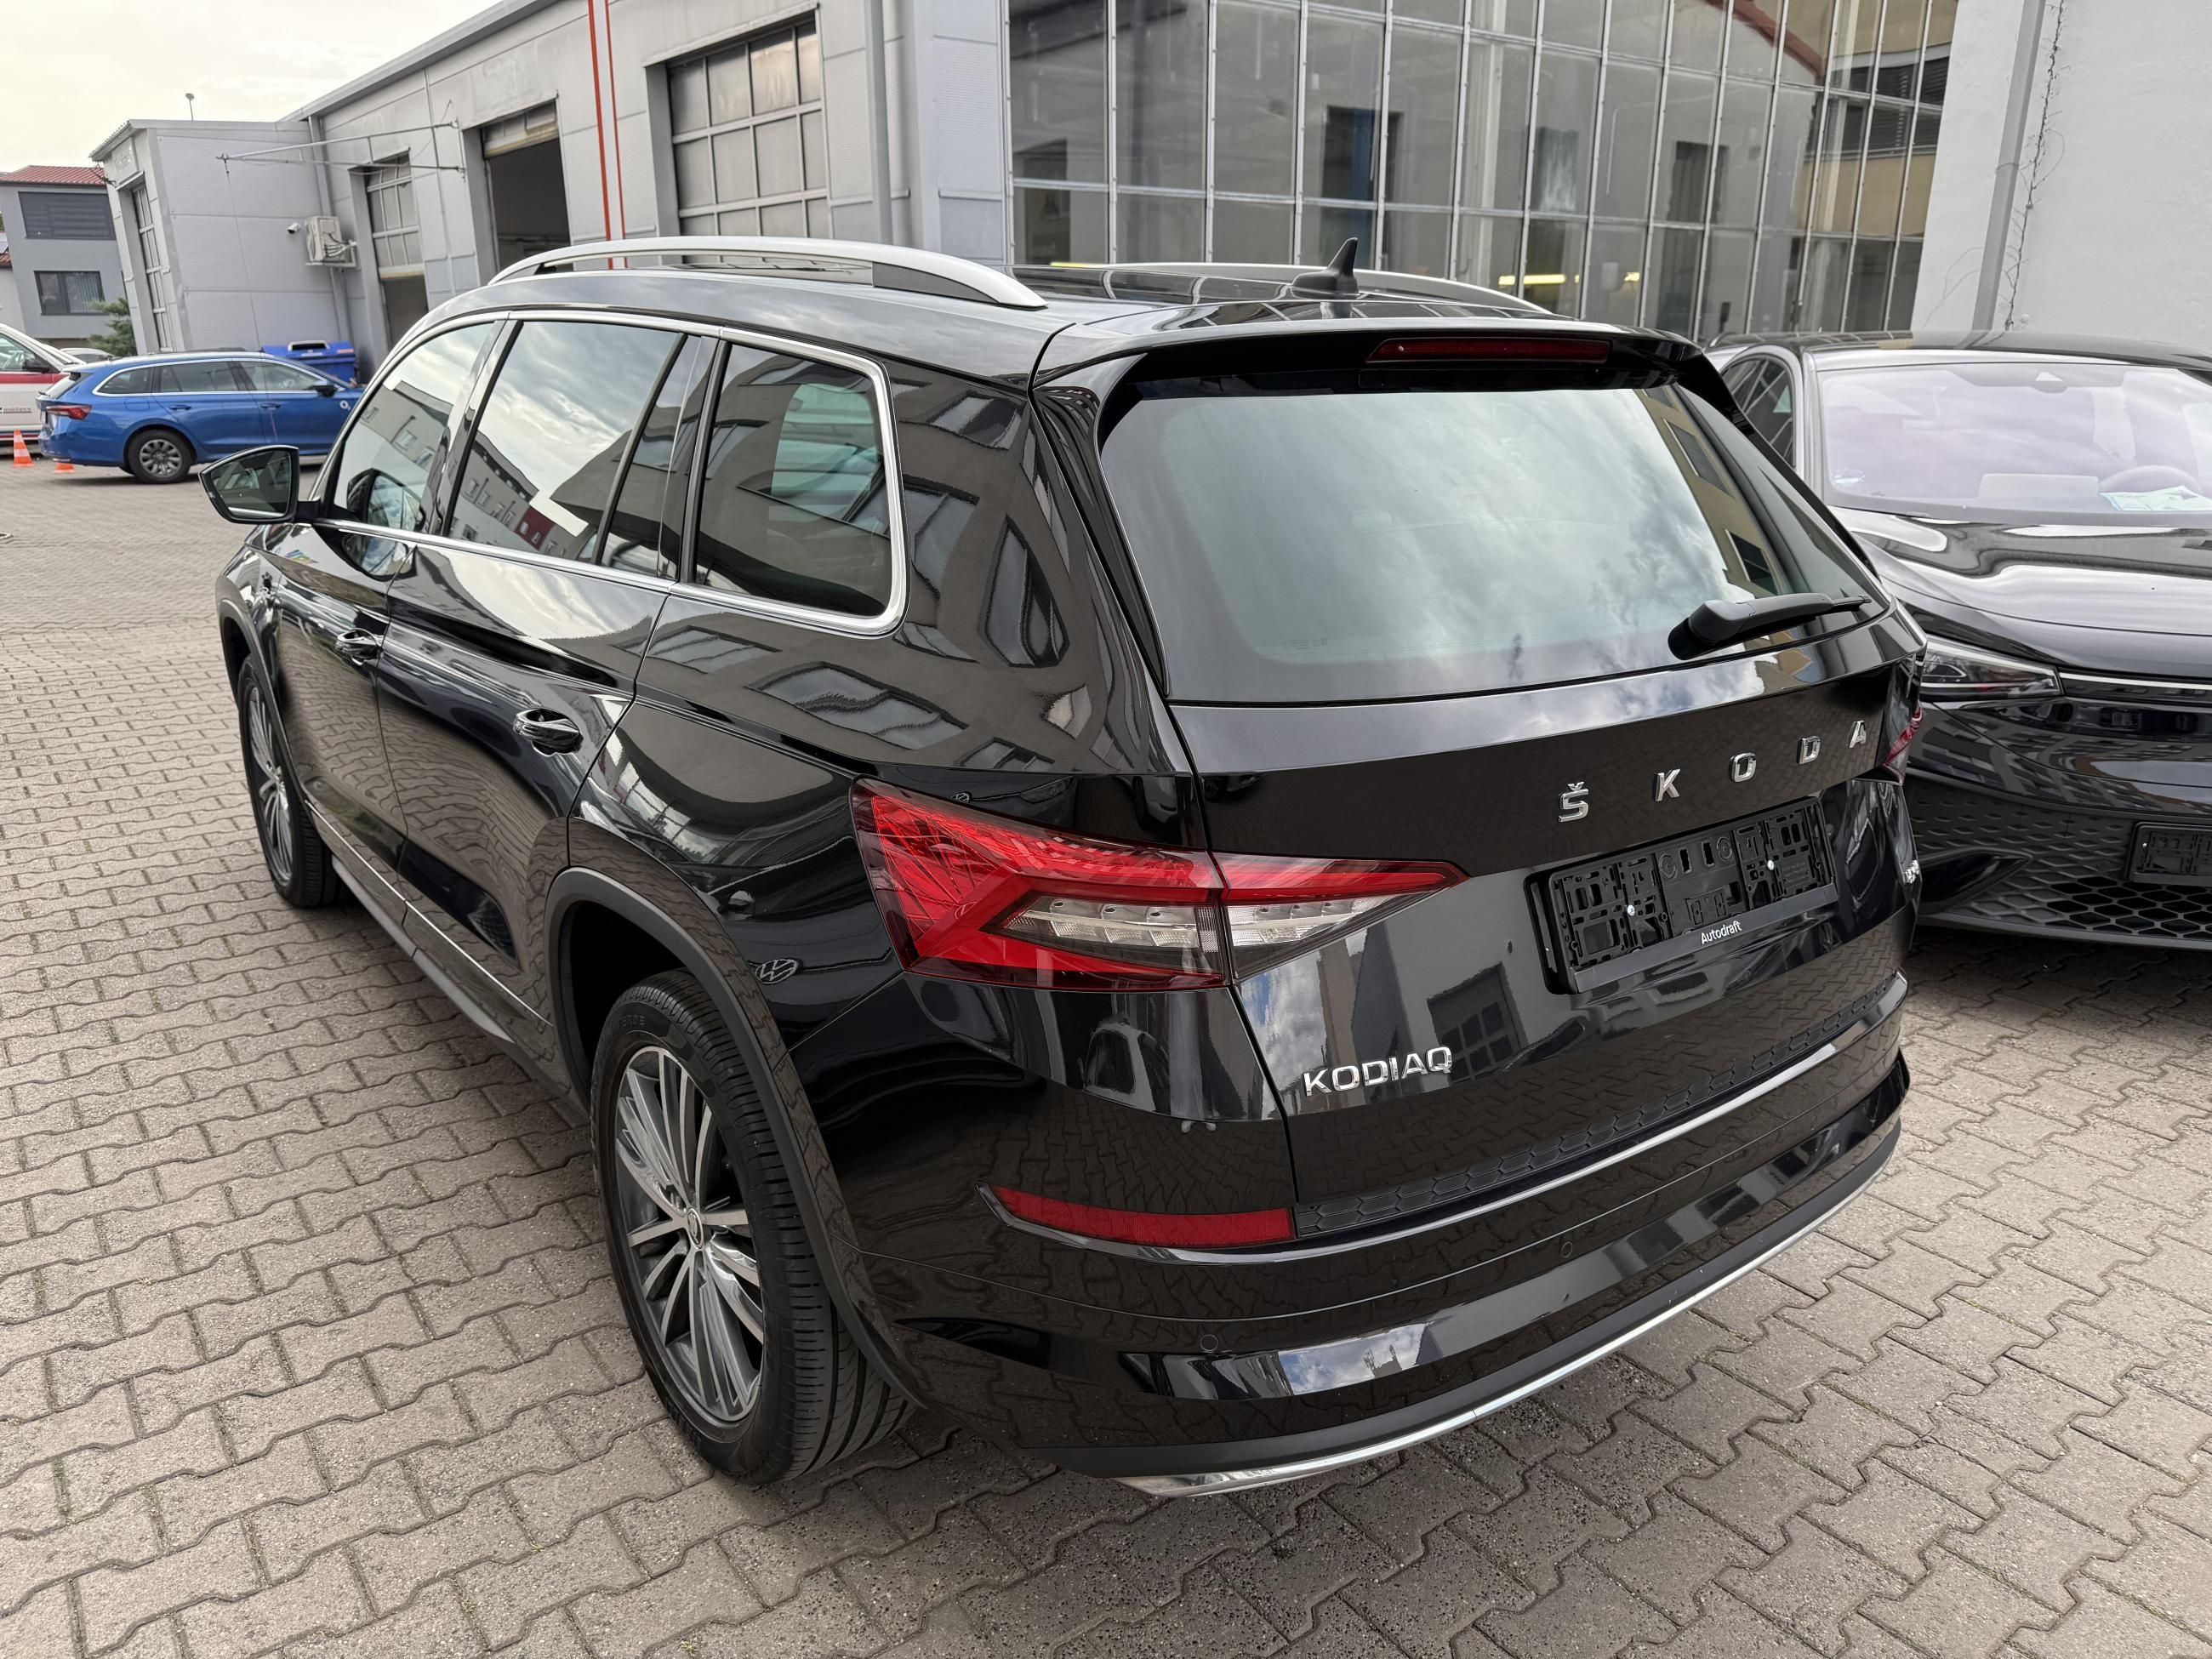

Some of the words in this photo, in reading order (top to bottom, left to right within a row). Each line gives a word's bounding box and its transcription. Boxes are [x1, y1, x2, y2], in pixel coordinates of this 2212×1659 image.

[1558, 720, 1867, 823] ŠKODA
[1702, 920, 1742, 944] Autodraft
[1303, 1046, 1453, 1097] KODIAQ
